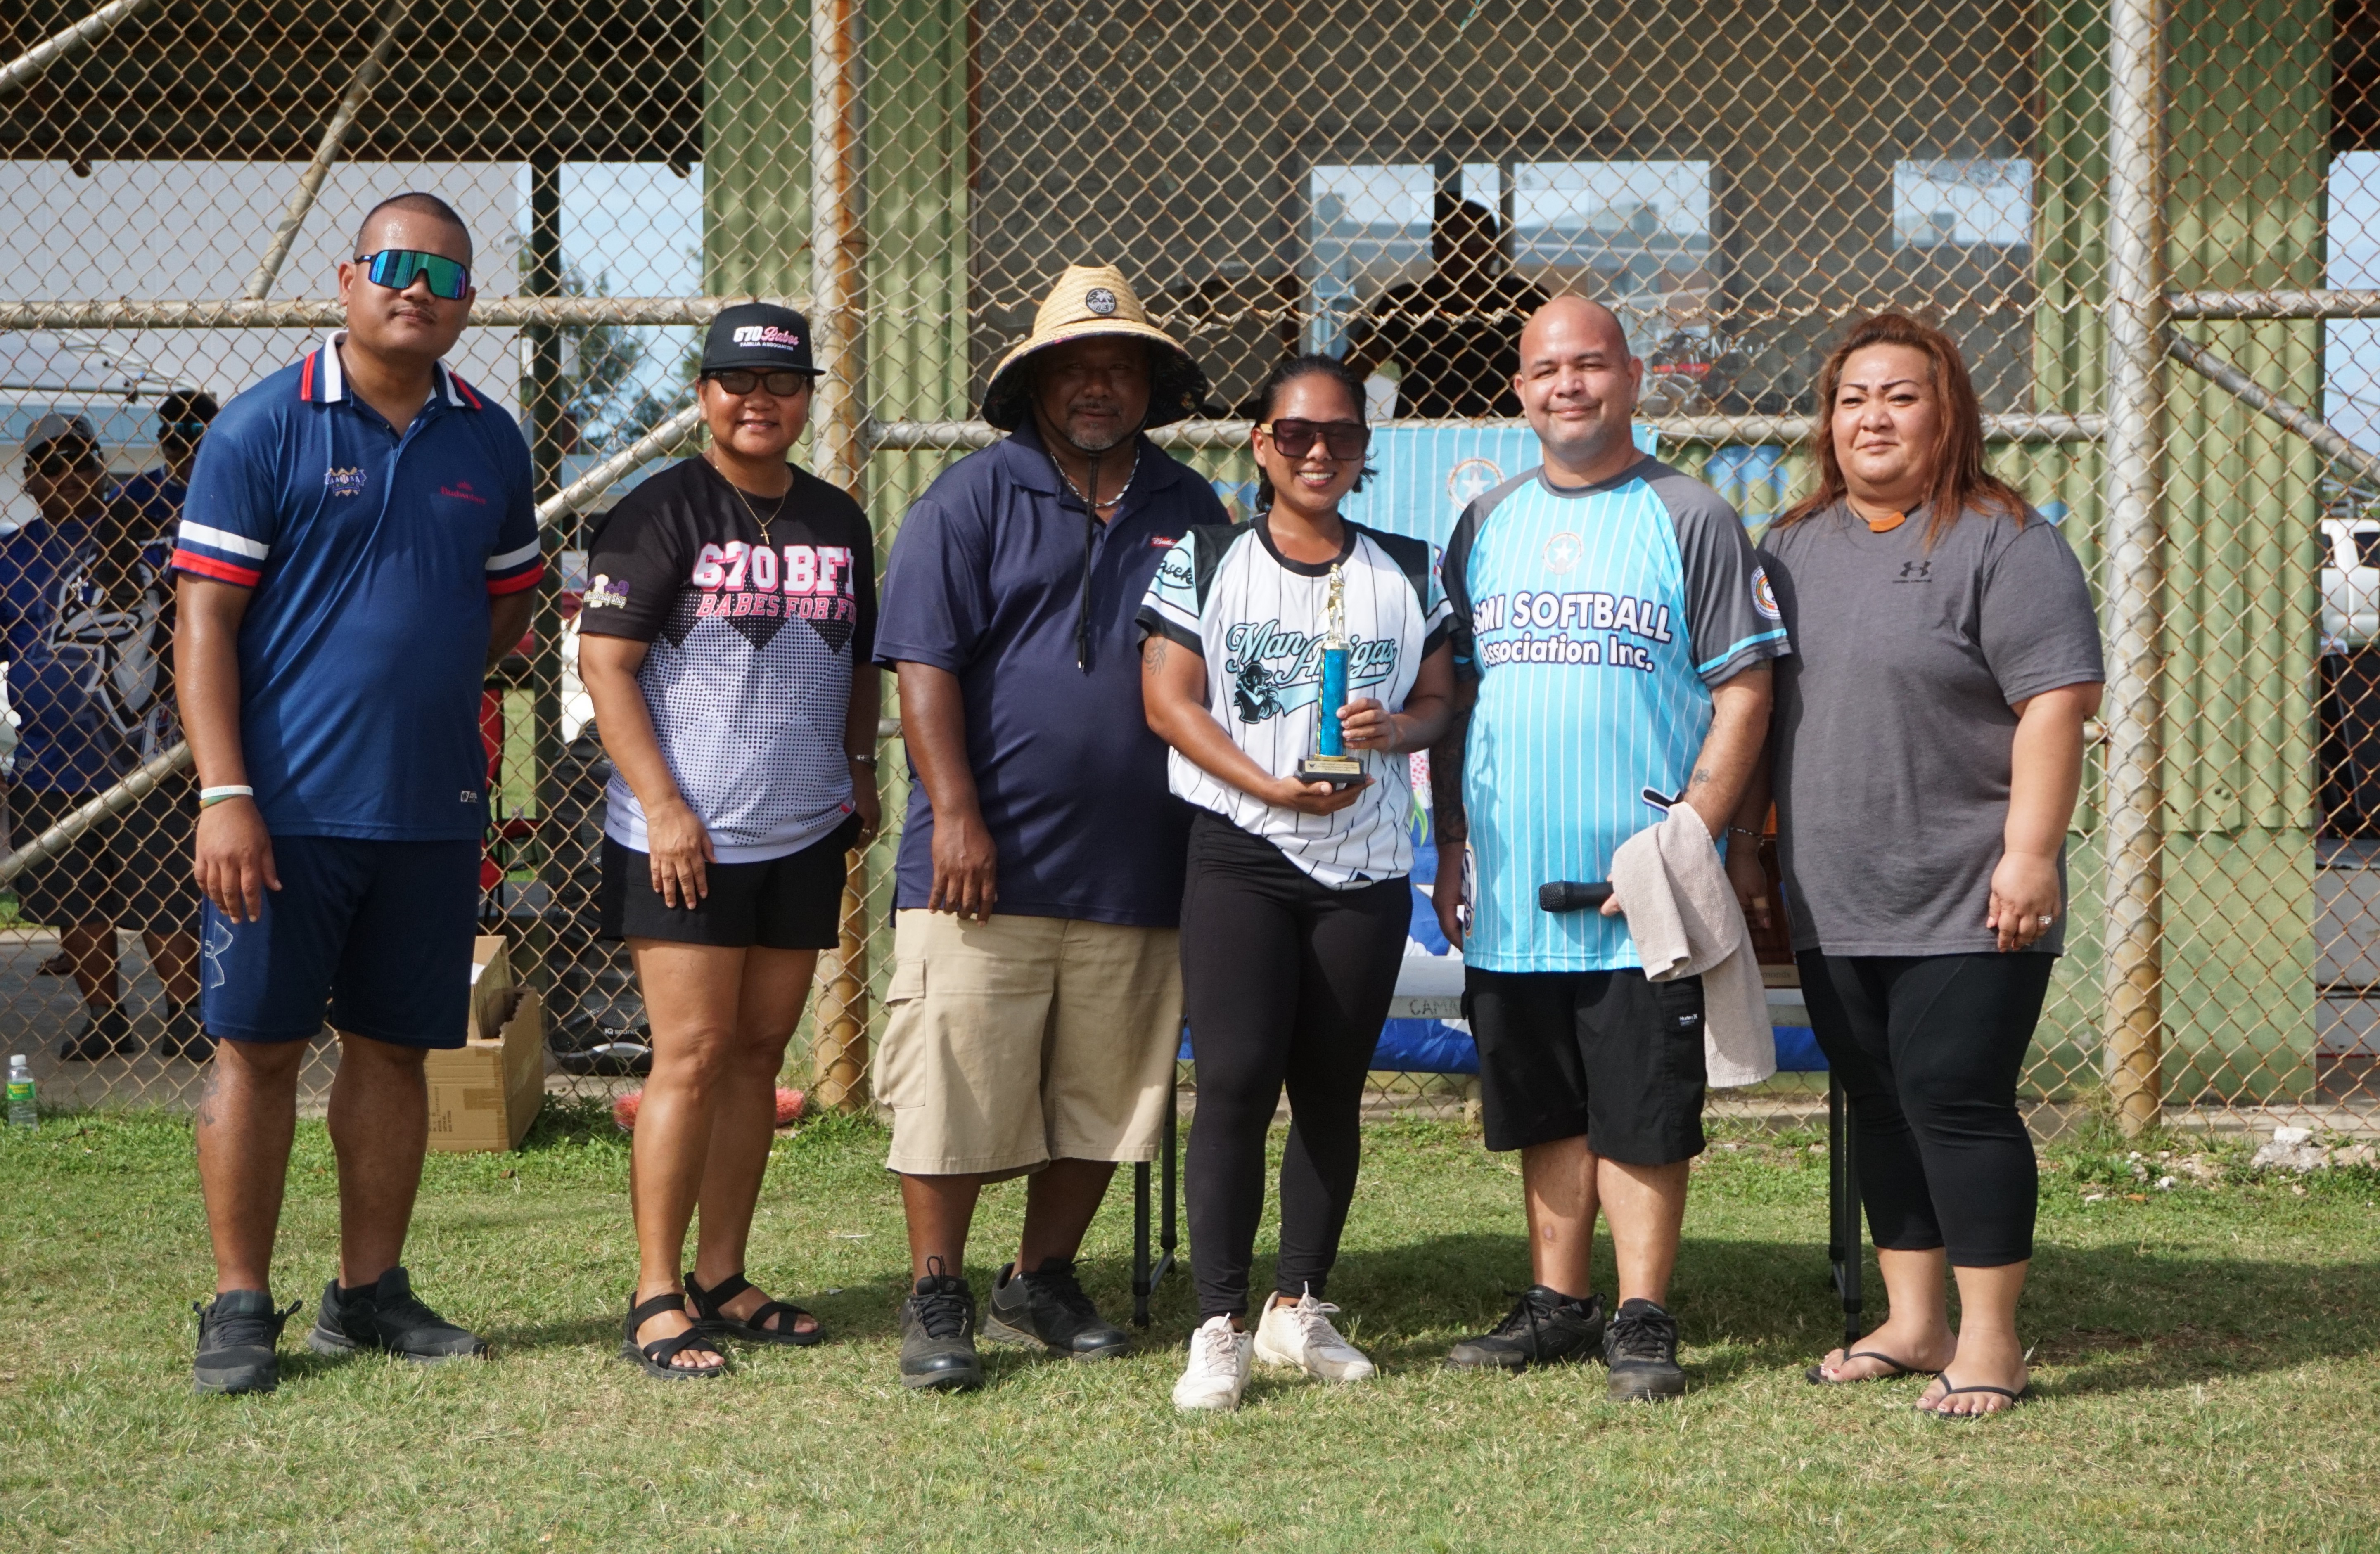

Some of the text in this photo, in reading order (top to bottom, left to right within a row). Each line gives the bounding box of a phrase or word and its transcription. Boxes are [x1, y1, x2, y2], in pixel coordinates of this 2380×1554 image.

[733, 326, 763, 342] 670
[762, 342, 794, 351] ASSOCIATION
[693, 540, 778, 592] 670
[612, 594, 626, 607] Shop
[696, 592, 780, 617] BABES
[785, 597, 830, 619] FOR
[1511, 591, 1672, 643] SOFTBALL
[1274, 629, 1398, 685] Aigas
[1479, 632, 1654, 671] Association Inc.
